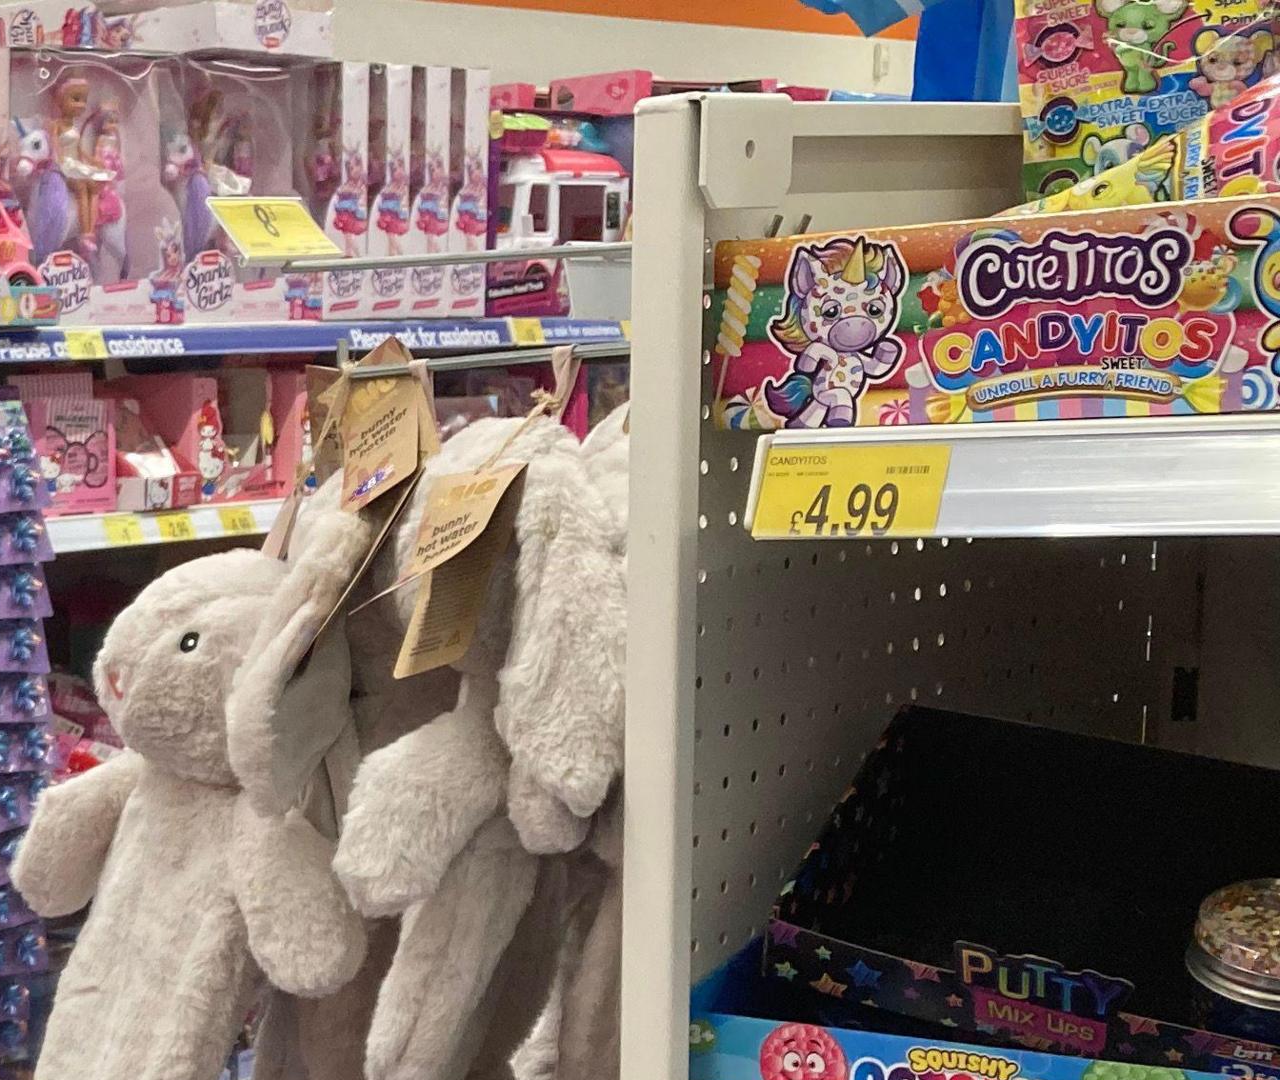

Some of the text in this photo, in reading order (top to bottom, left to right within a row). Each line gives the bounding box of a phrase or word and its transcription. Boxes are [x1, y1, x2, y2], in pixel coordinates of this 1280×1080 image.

[1038, 62, 1079, 83] SUPER
[1089, 97, 1134, 117] EXTRA
[1148, 91, 1194, 111] EXTRA
[1098, 110, 1145, 128] SWEET
[187, 263, 230, 295] Sparkle
[197, 285, 231, 310] Girlz
[109, 336, 185, 356] assistance
[933, 311, 1218, 375] CANDYITOS
[1101, 356, 1145, 371] SWEET
[975, 371, 1172, 403] UNROLL A FURRY FRIEND
[360, 406, 396, 440] bunny
[369, 408, 408, 440] water
[770, 455, 828, 466] CANDYITOS
[790, 482, 900, 537] £4.99
[431, 512, 472, 538] bunny
[416, 520, 479, 557] hot water
[961, 948, 1124, 1018] PUTTY
